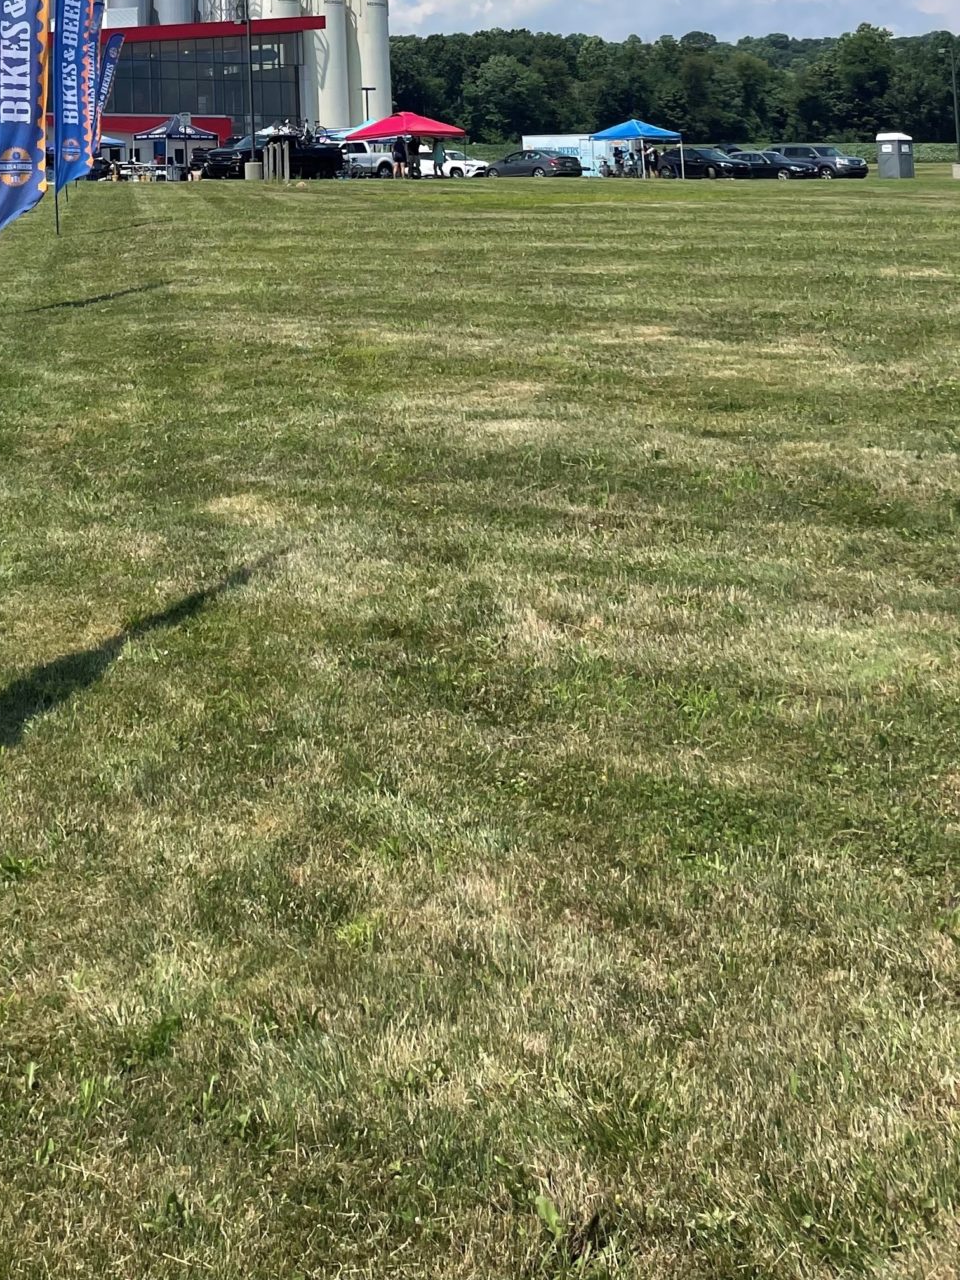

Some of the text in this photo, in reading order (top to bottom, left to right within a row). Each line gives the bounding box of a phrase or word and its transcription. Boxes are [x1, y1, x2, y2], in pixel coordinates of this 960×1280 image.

[0, 20, 32, 125] BIKES
[63, 47, 76, 61] &
[61, 62, 79, 126] BIKES
